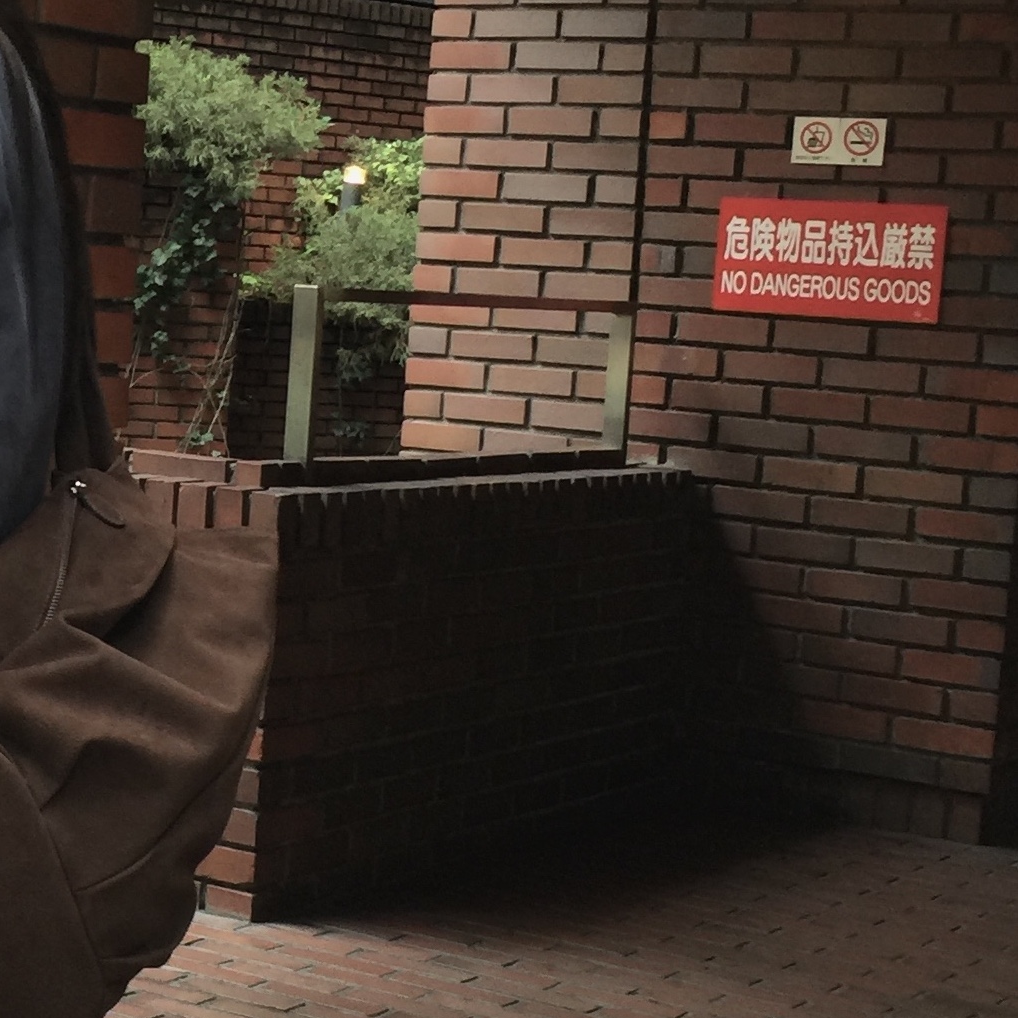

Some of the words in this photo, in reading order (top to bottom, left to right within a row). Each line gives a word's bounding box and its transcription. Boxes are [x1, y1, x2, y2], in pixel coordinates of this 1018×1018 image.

[723, 215, 937, 271] 危険物品持込厳禁
[720, 270, 747, 295] NO
[750, 272, 860, 302] DANGEROUS
[863, 278, 932, 306] GOODS
